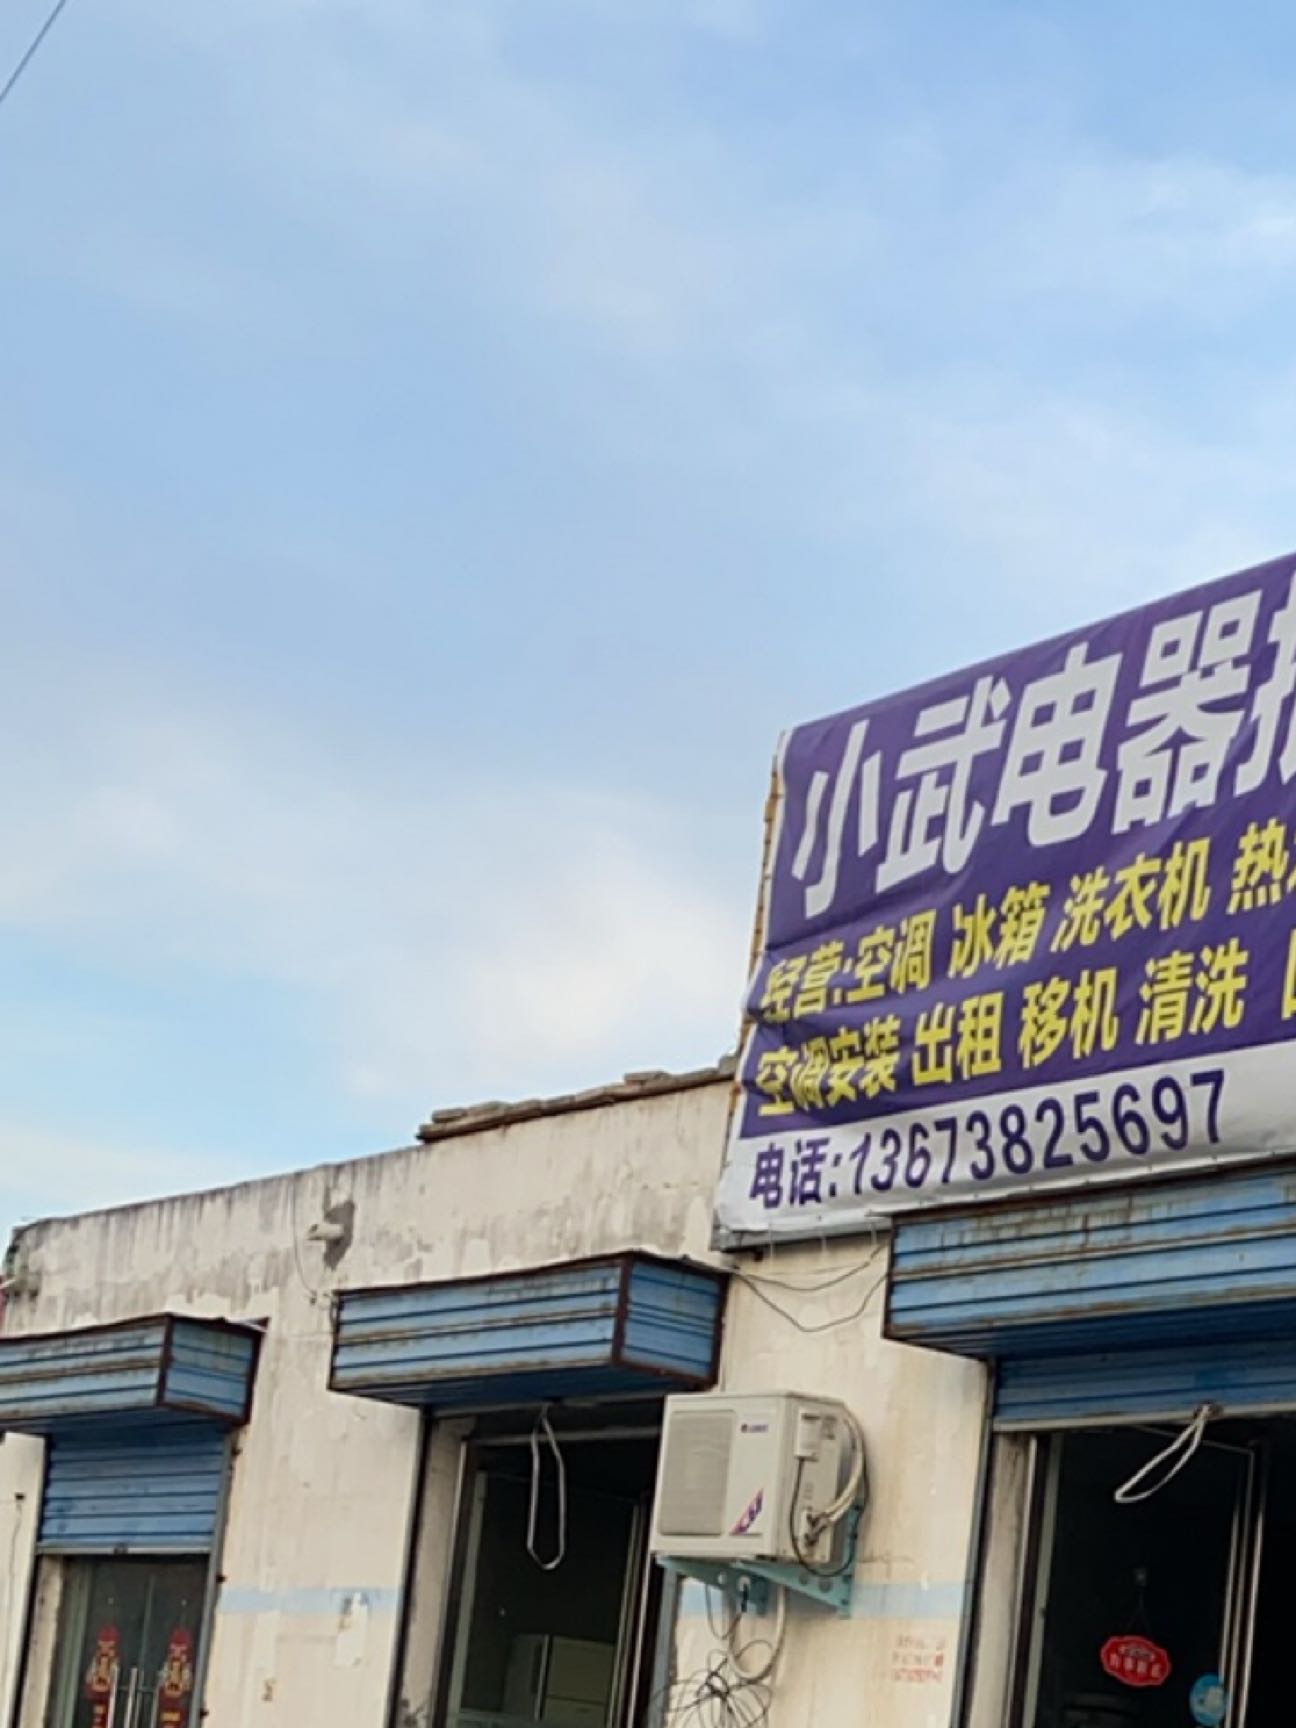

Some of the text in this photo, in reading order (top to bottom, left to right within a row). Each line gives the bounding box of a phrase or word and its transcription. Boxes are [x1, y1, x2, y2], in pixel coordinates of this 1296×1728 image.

[947, 880, 1051, 979] 冰箱
[1051, 838, 1210, 953] 洗衣机
[756, 1014, 900, 1117] 空调安装
[911, 992, 1005, 1087] 出租
[1018, 966, 1118, 1070] 移机
[1134, 938, 1249, 1045] 清洗
[749, 1069, 1225, 1212] 电话:13673825697
